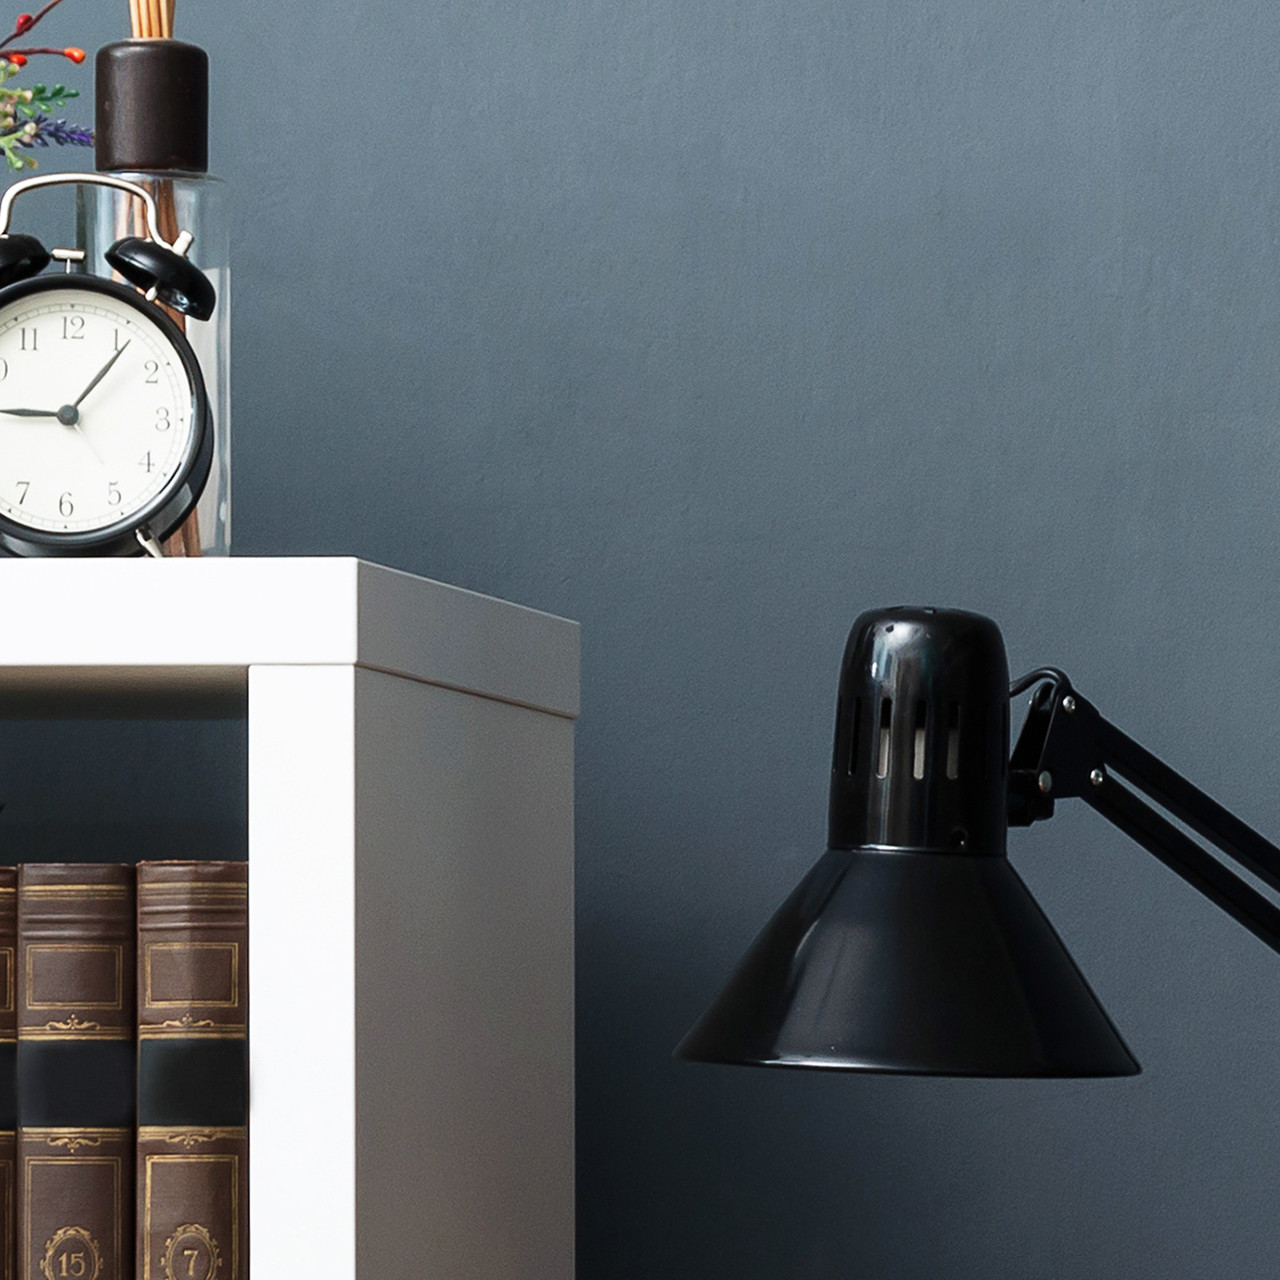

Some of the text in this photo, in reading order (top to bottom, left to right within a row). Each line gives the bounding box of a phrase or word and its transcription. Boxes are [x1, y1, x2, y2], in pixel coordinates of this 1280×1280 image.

[20, 328, 38, 351] 11
[62, 316, 85, 340] 12
[113, 328, 120, 351] 1
[144, 360, 159, 384] 2
[155, 407, 171, 432] 3
[138, 451, 155, 473] 4
[16, 481, 30, 506] 7
[59, 492, 74, 517] 6
[107, 482, 122, 506] 5
[58, 1252, 86, 1277] 15
[183, 1250, 199, 1276] 7
